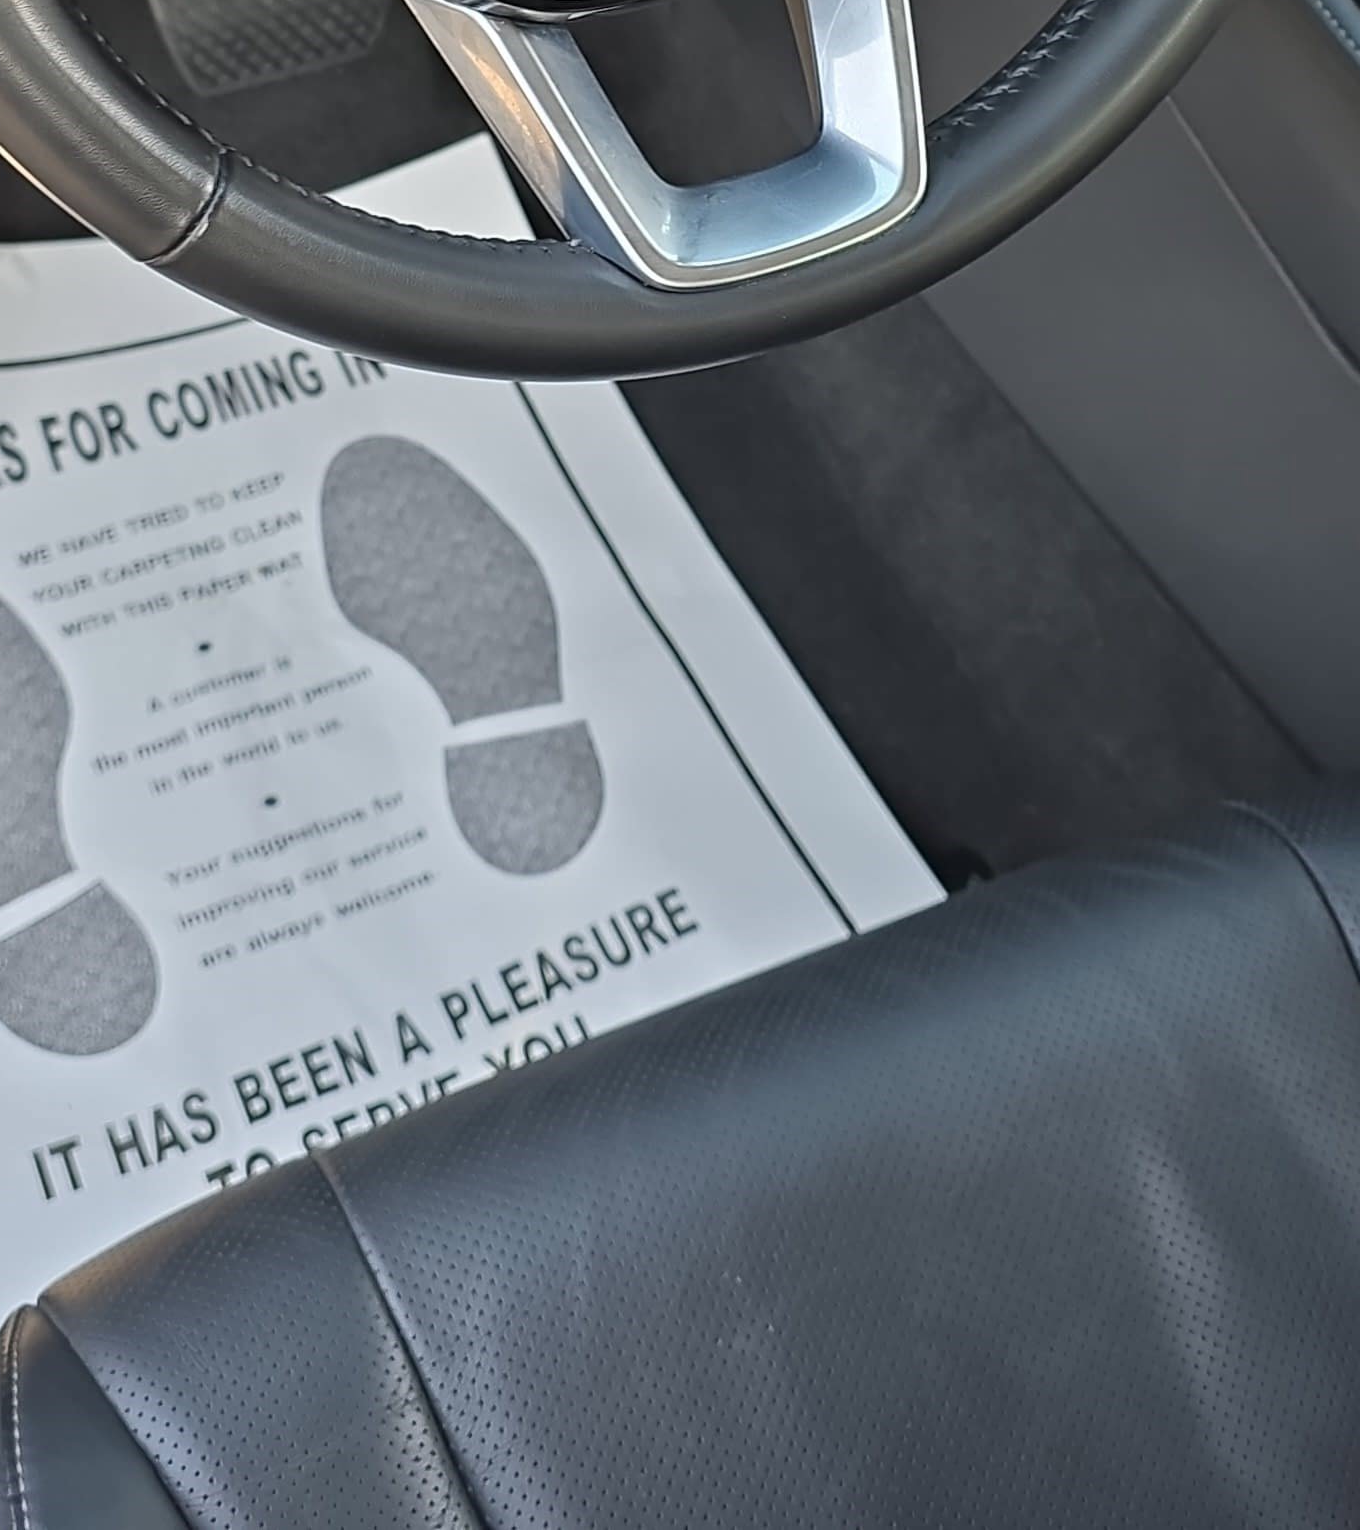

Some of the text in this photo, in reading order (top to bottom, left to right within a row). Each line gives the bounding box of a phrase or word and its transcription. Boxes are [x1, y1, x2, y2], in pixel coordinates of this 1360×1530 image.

[41, 401, 138, 474] FOR
[148, 350, 324, 440] COMING
[19, 472, 285, 567] WE HAVE TRIED TO KEEP
[33, 509, 303, 603] YOUR CARPETING CLEAN
[61, 552, 303, 638] WITH THIS PAPER MAT
[93, 667, 373, 773] the most important person
[148, 656, 291, 712] A customer is
[151, 777, 172, 795] in
[179, 762, 213, 783] the
[223, 736, 280, 766] world
[287, 729, 309, 746] to
[168, 792, 404, 886] Your suggestions for
[178, 826, 427, 929] improving our service
[200, 871, 433, 968] are always welcome
[31, 887, 700, 1200] IT HAS BEEN A PLEASURE
